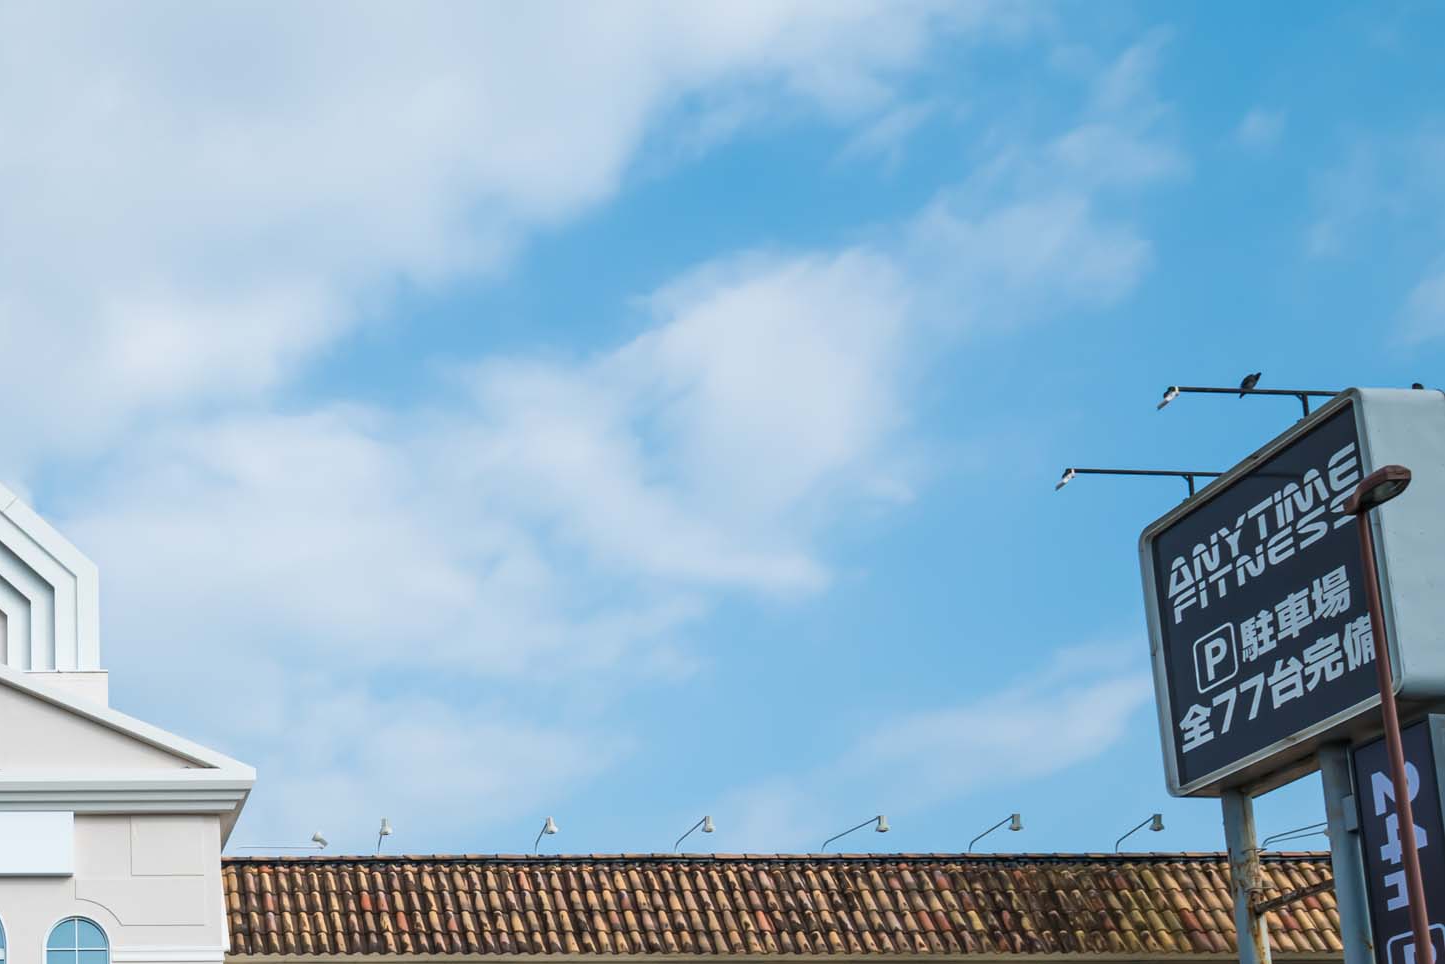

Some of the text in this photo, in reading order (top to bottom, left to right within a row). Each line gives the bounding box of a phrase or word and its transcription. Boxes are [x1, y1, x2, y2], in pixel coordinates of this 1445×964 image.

[1168, 442, 1360, 599] ANYTIME
[1179, 612, 1377, 753] 全77台完備
[1204, 565, 1351, 682] P 駐車場
